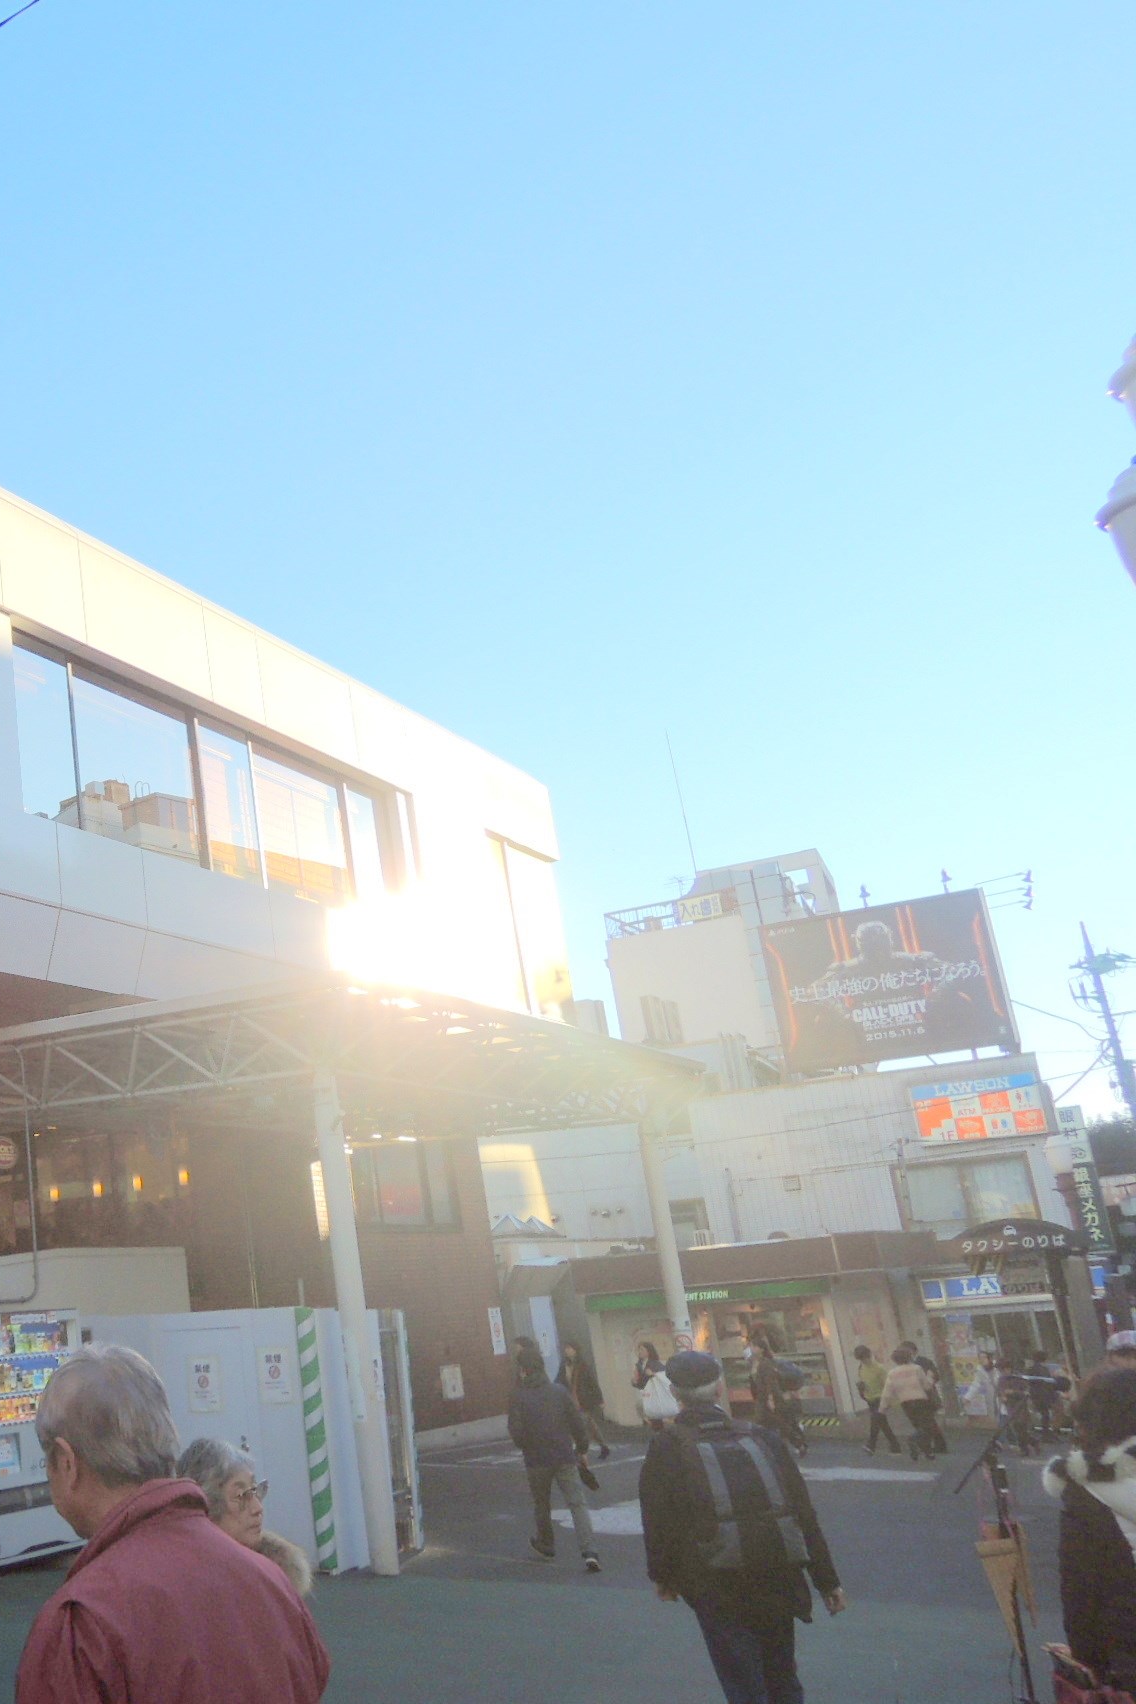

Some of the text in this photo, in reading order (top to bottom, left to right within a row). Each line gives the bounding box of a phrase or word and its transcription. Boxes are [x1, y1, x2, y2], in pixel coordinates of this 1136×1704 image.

[852, 1005, 888, 1024] CALL
[888, 998, 927, 1017] DUTY
[934, 1076, 1011, 1097] LAWSON
[940, 1131, 955, 1142] 1F
[961, 1234, 1066, 1254] タクシーのりば
[699, 1289, 730, 1301] STATION
